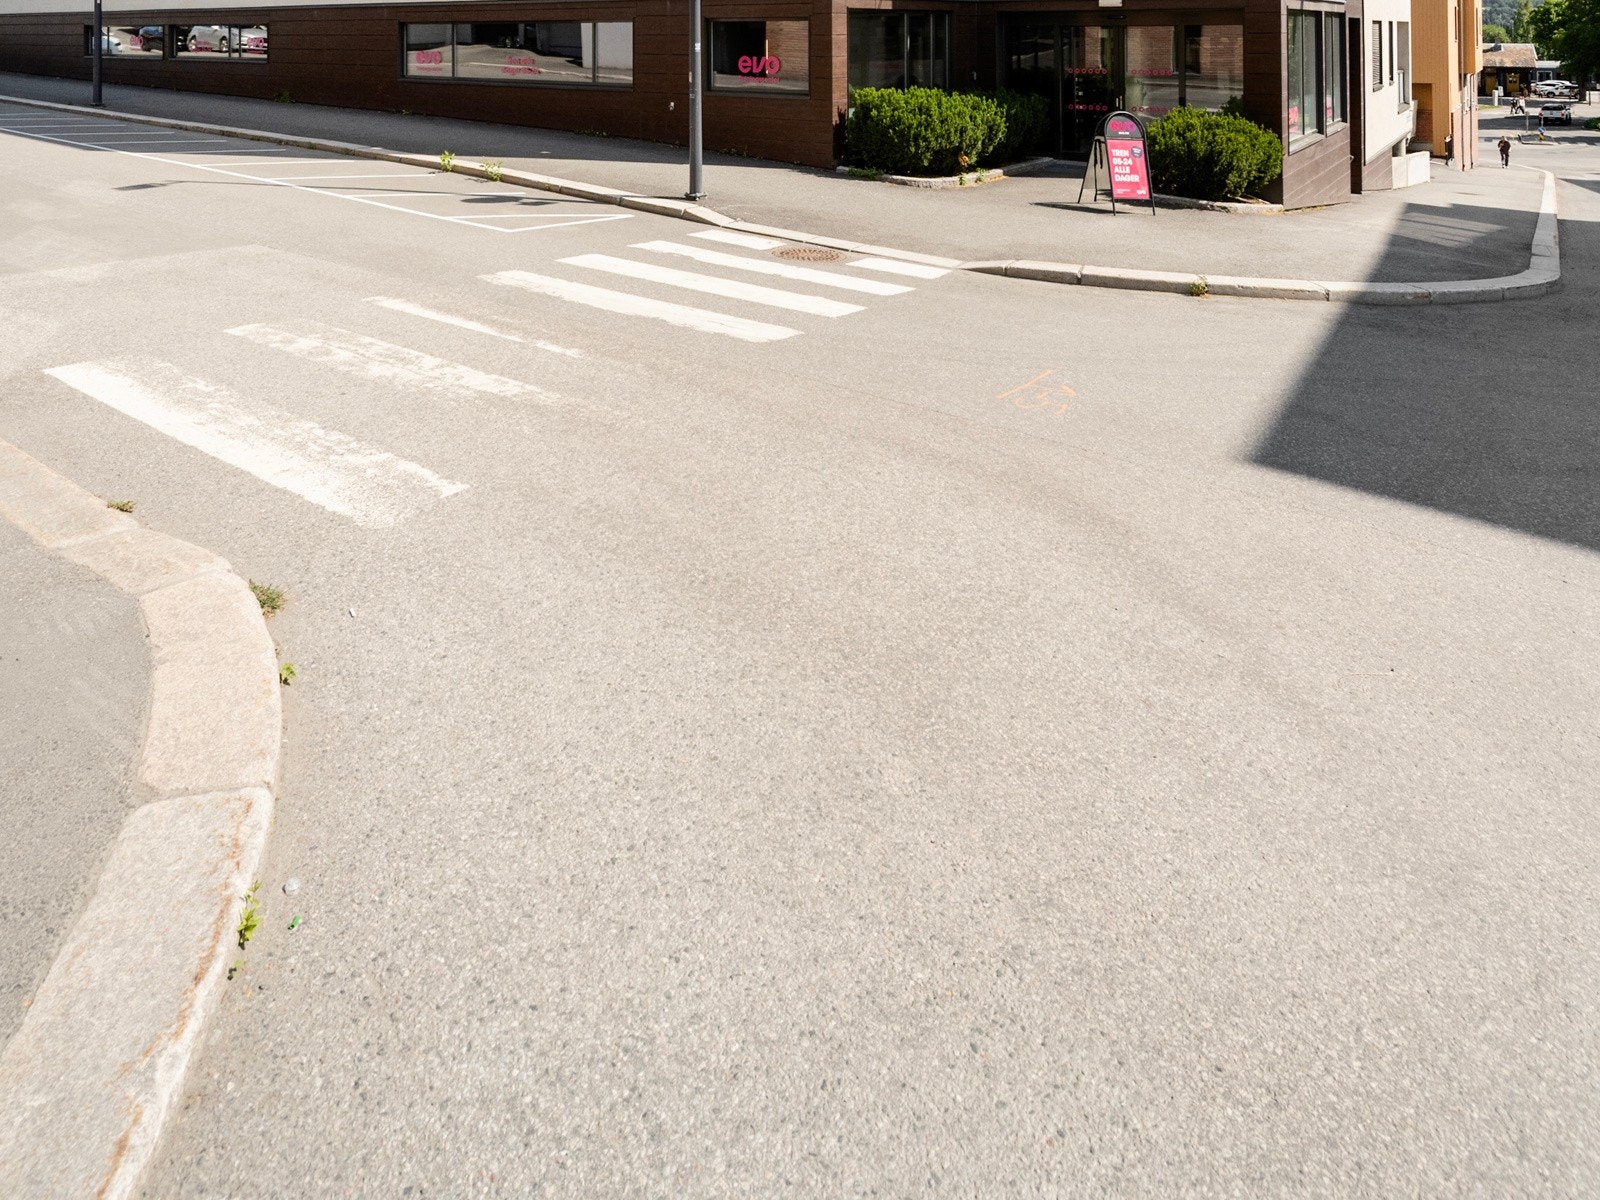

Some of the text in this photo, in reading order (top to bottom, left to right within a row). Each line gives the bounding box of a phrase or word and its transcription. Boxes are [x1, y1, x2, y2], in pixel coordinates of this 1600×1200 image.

[738, 55, 780, 75] evo
[1110, 121, 1136, 132] evo
[1111, 149, 1129, 157] TREN
[1115, 174, 1139, 182] DAGER
